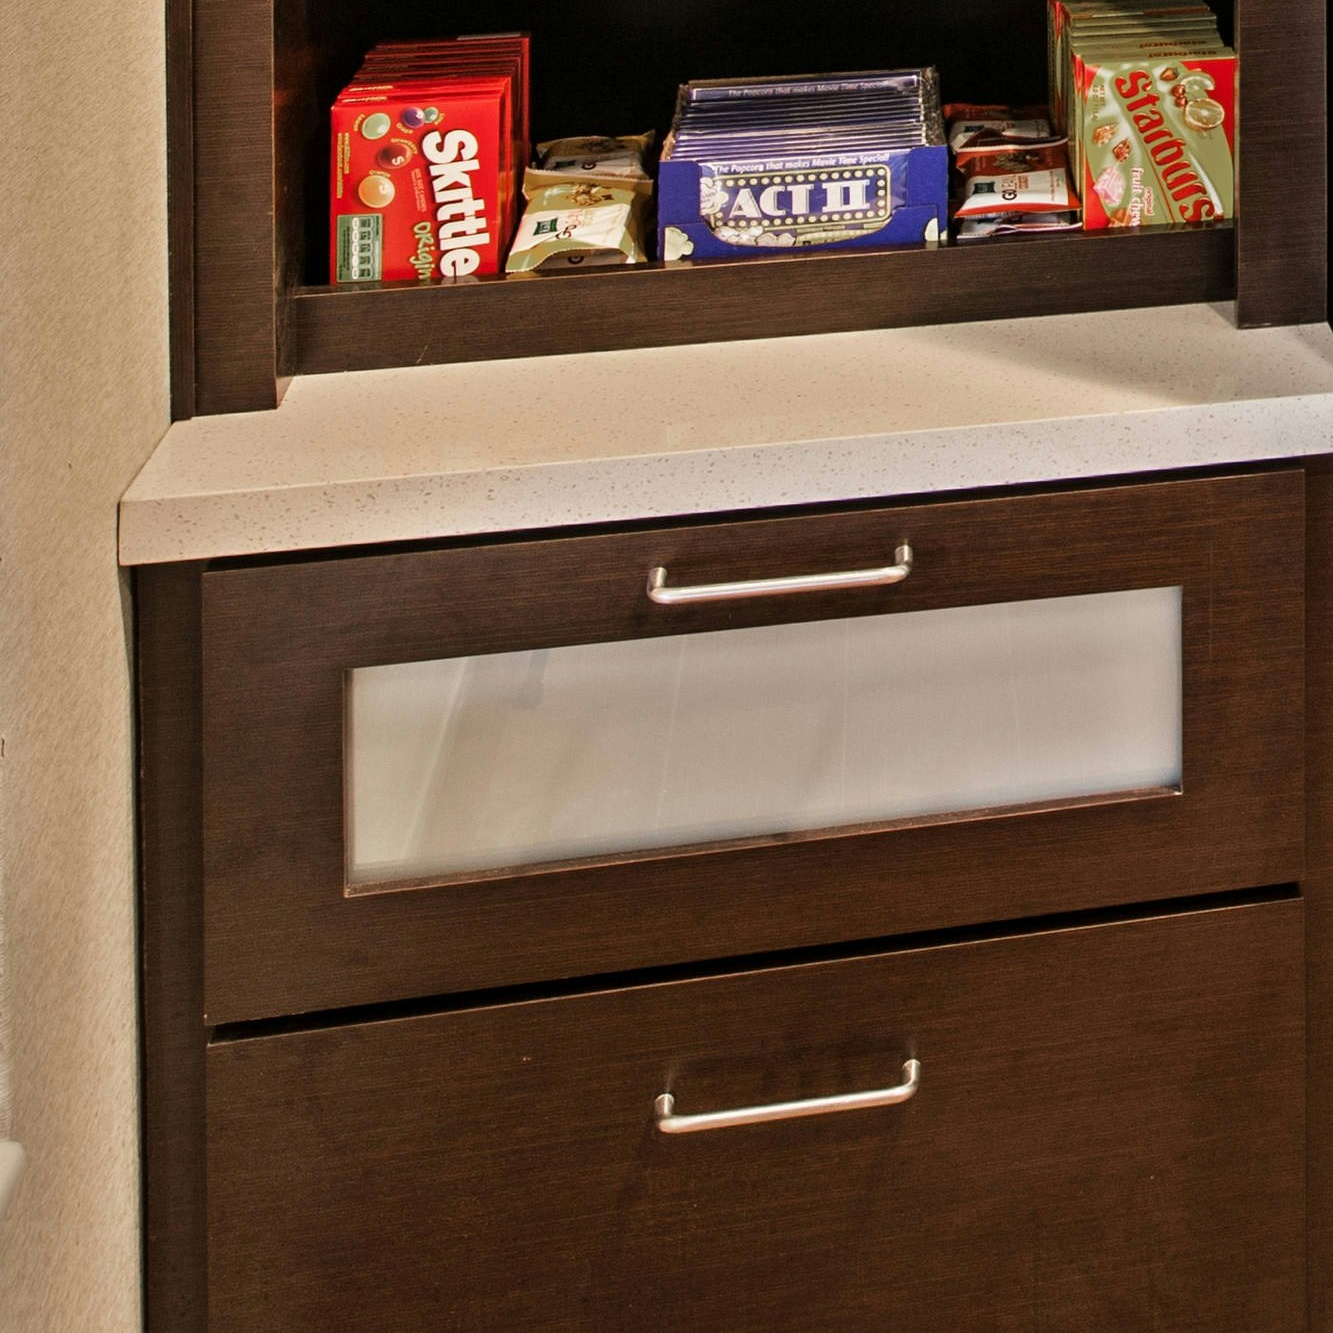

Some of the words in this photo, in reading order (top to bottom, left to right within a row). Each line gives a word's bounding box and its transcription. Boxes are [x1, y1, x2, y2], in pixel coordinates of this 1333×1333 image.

[422, 128, 491, 278] Skittle
[729, 183, 816, 219] ACT
[822, 179, 871, 214] II
[1114, 69, 1225, 223] Starburs
